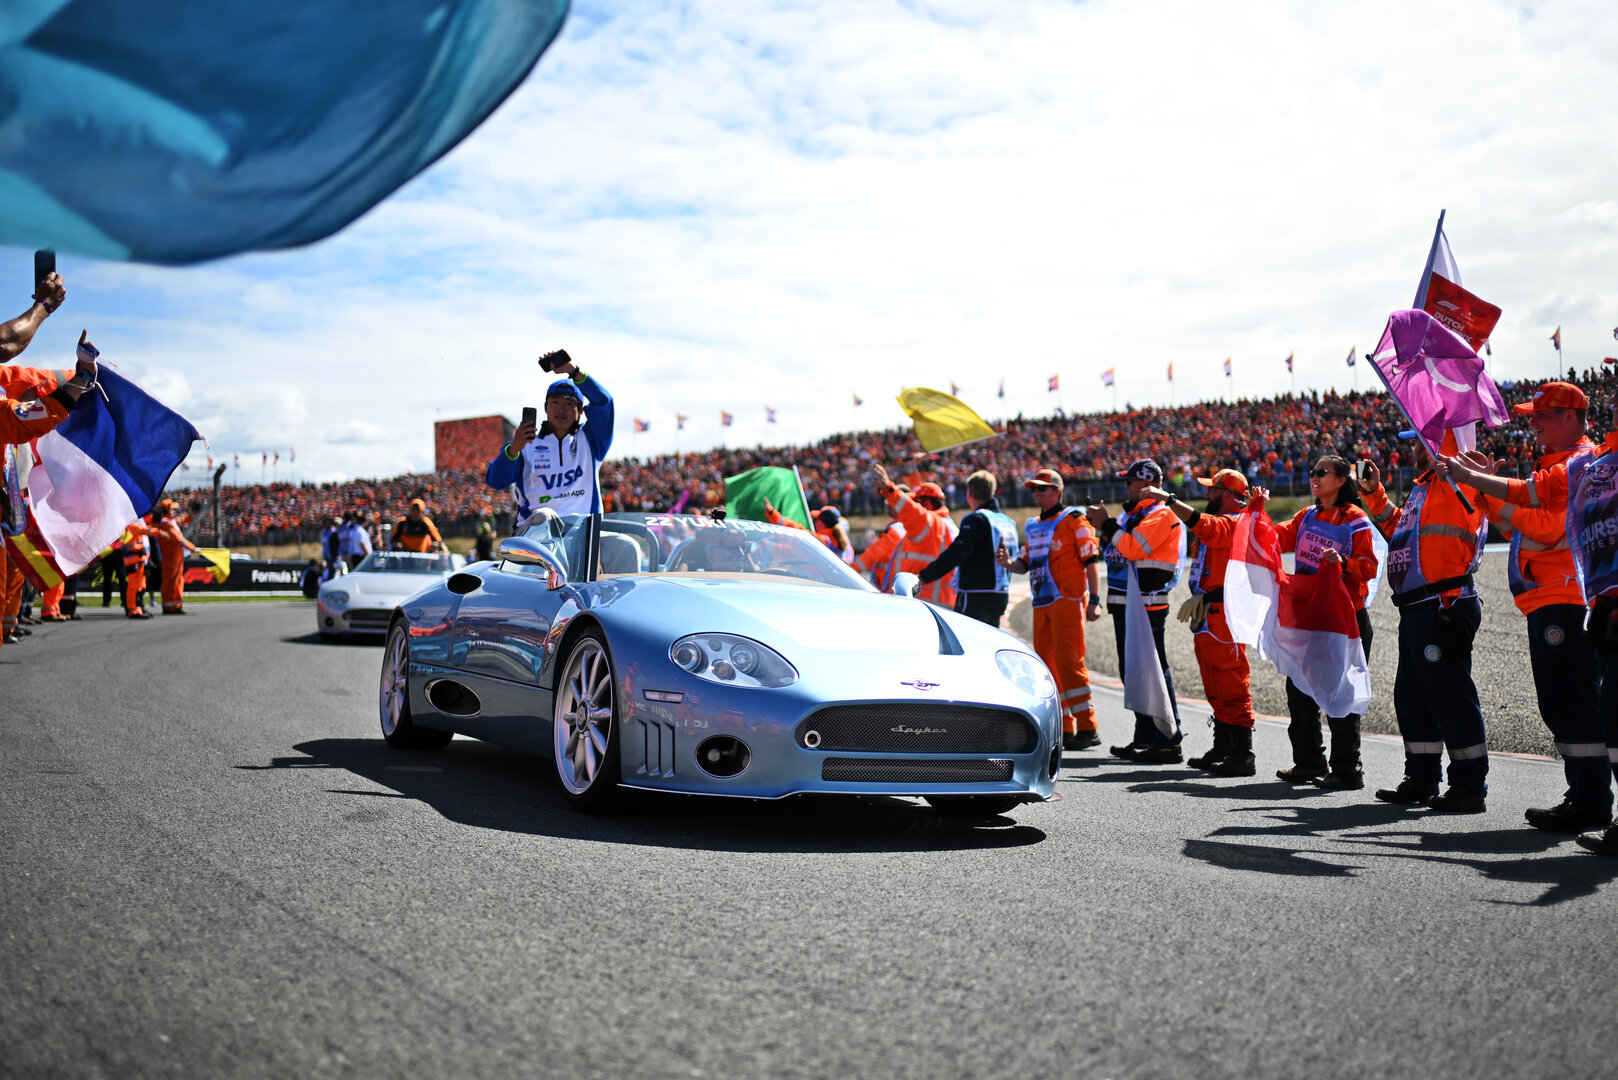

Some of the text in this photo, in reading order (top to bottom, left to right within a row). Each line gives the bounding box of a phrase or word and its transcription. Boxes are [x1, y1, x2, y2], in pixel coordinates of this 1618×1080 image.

[1433, 311, 1465, 331] DUTCH
[537, 465, 583, 490] VISA
[645, 516, 673, 527] 22
[673, 517, 727, 529] YUKI
[252, 569, 291, 583] Formula
[890, 724, 948, 735] Spyker
